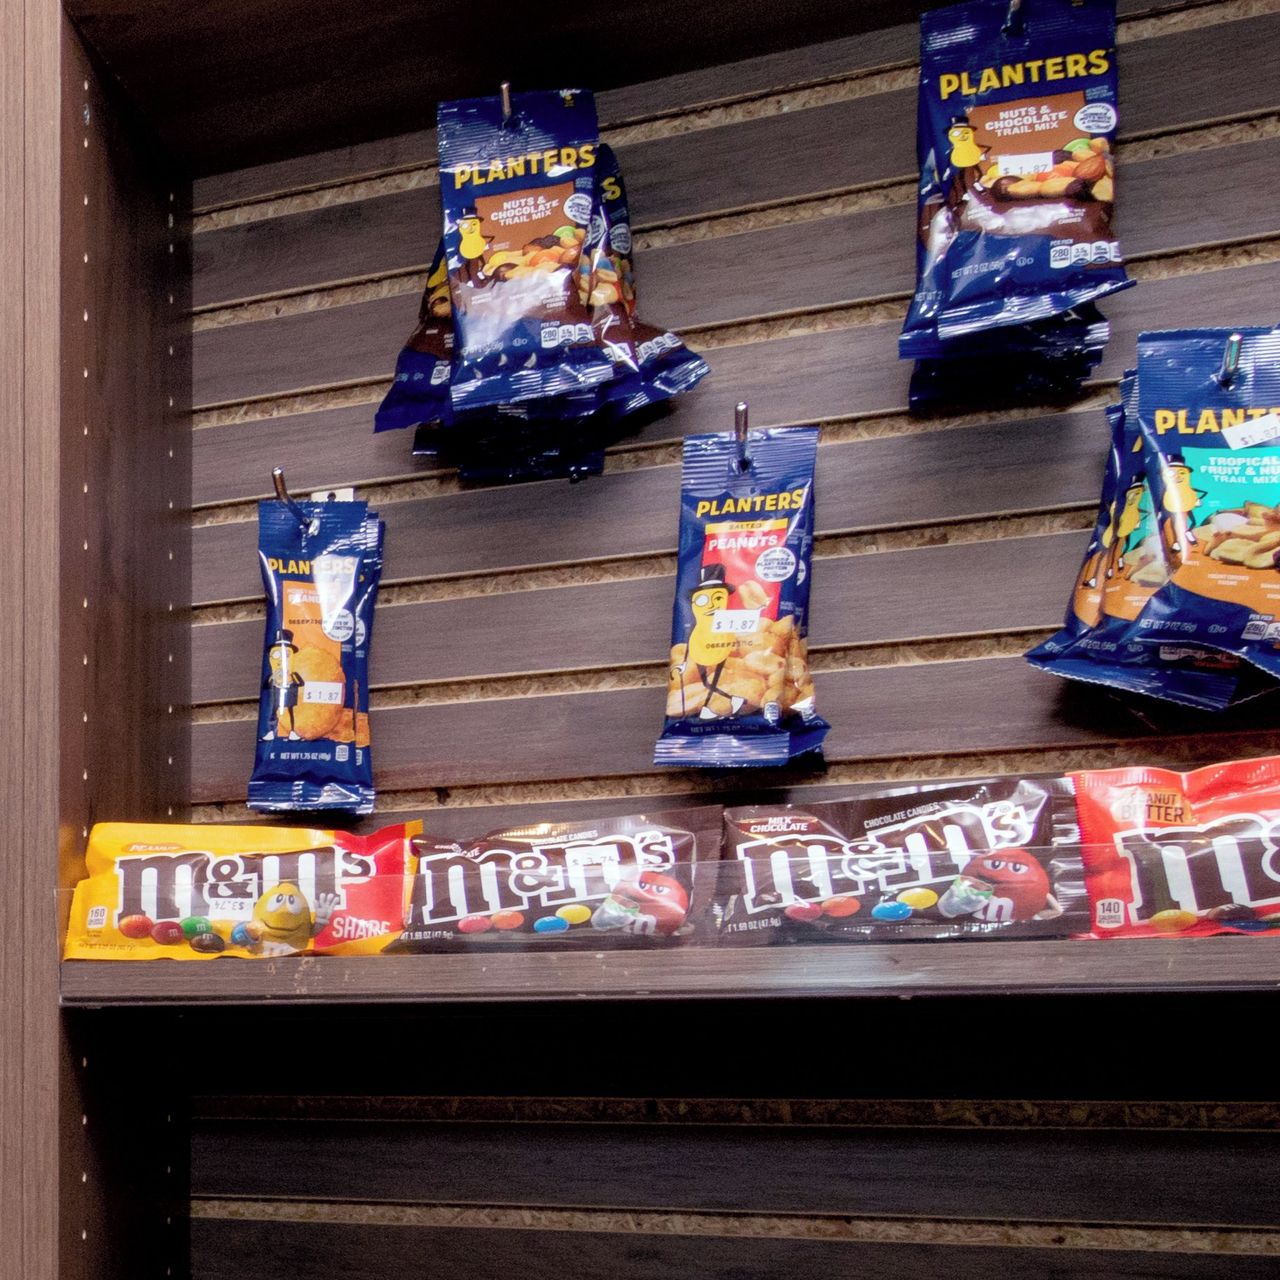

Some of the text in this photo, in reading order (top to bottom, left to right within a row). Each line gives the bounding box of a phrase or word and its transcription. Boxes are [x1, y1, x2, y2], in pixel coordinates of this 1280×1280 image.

[940, 50, 1110, 100] PLANTERS
[985, 110, 1068, 131] CHOCOLATE
[999, 106, 1038, 120] NUTS
[994, 120, 1060, 137] TRAIL MIX
[454, 144, 596, 190] PLANTERS
[491, 200, 559, 221] CHOCOLATE
[503, 197, 535, 210] NUTS
[500, 209, 552, 226] TRAIL MIX
[1212, 474, 1249, 484] TRAIL
[696, 489, 805, 518] PLANTERS
[708, 535, 778, 551] PEANUTS
[907, 802, 939, 819] CANDIES
[751, 823, 808, 832] CHOCOLATE
[769, 817, 792, 825] MILK
[1100, 902, 1120, 914] 140
